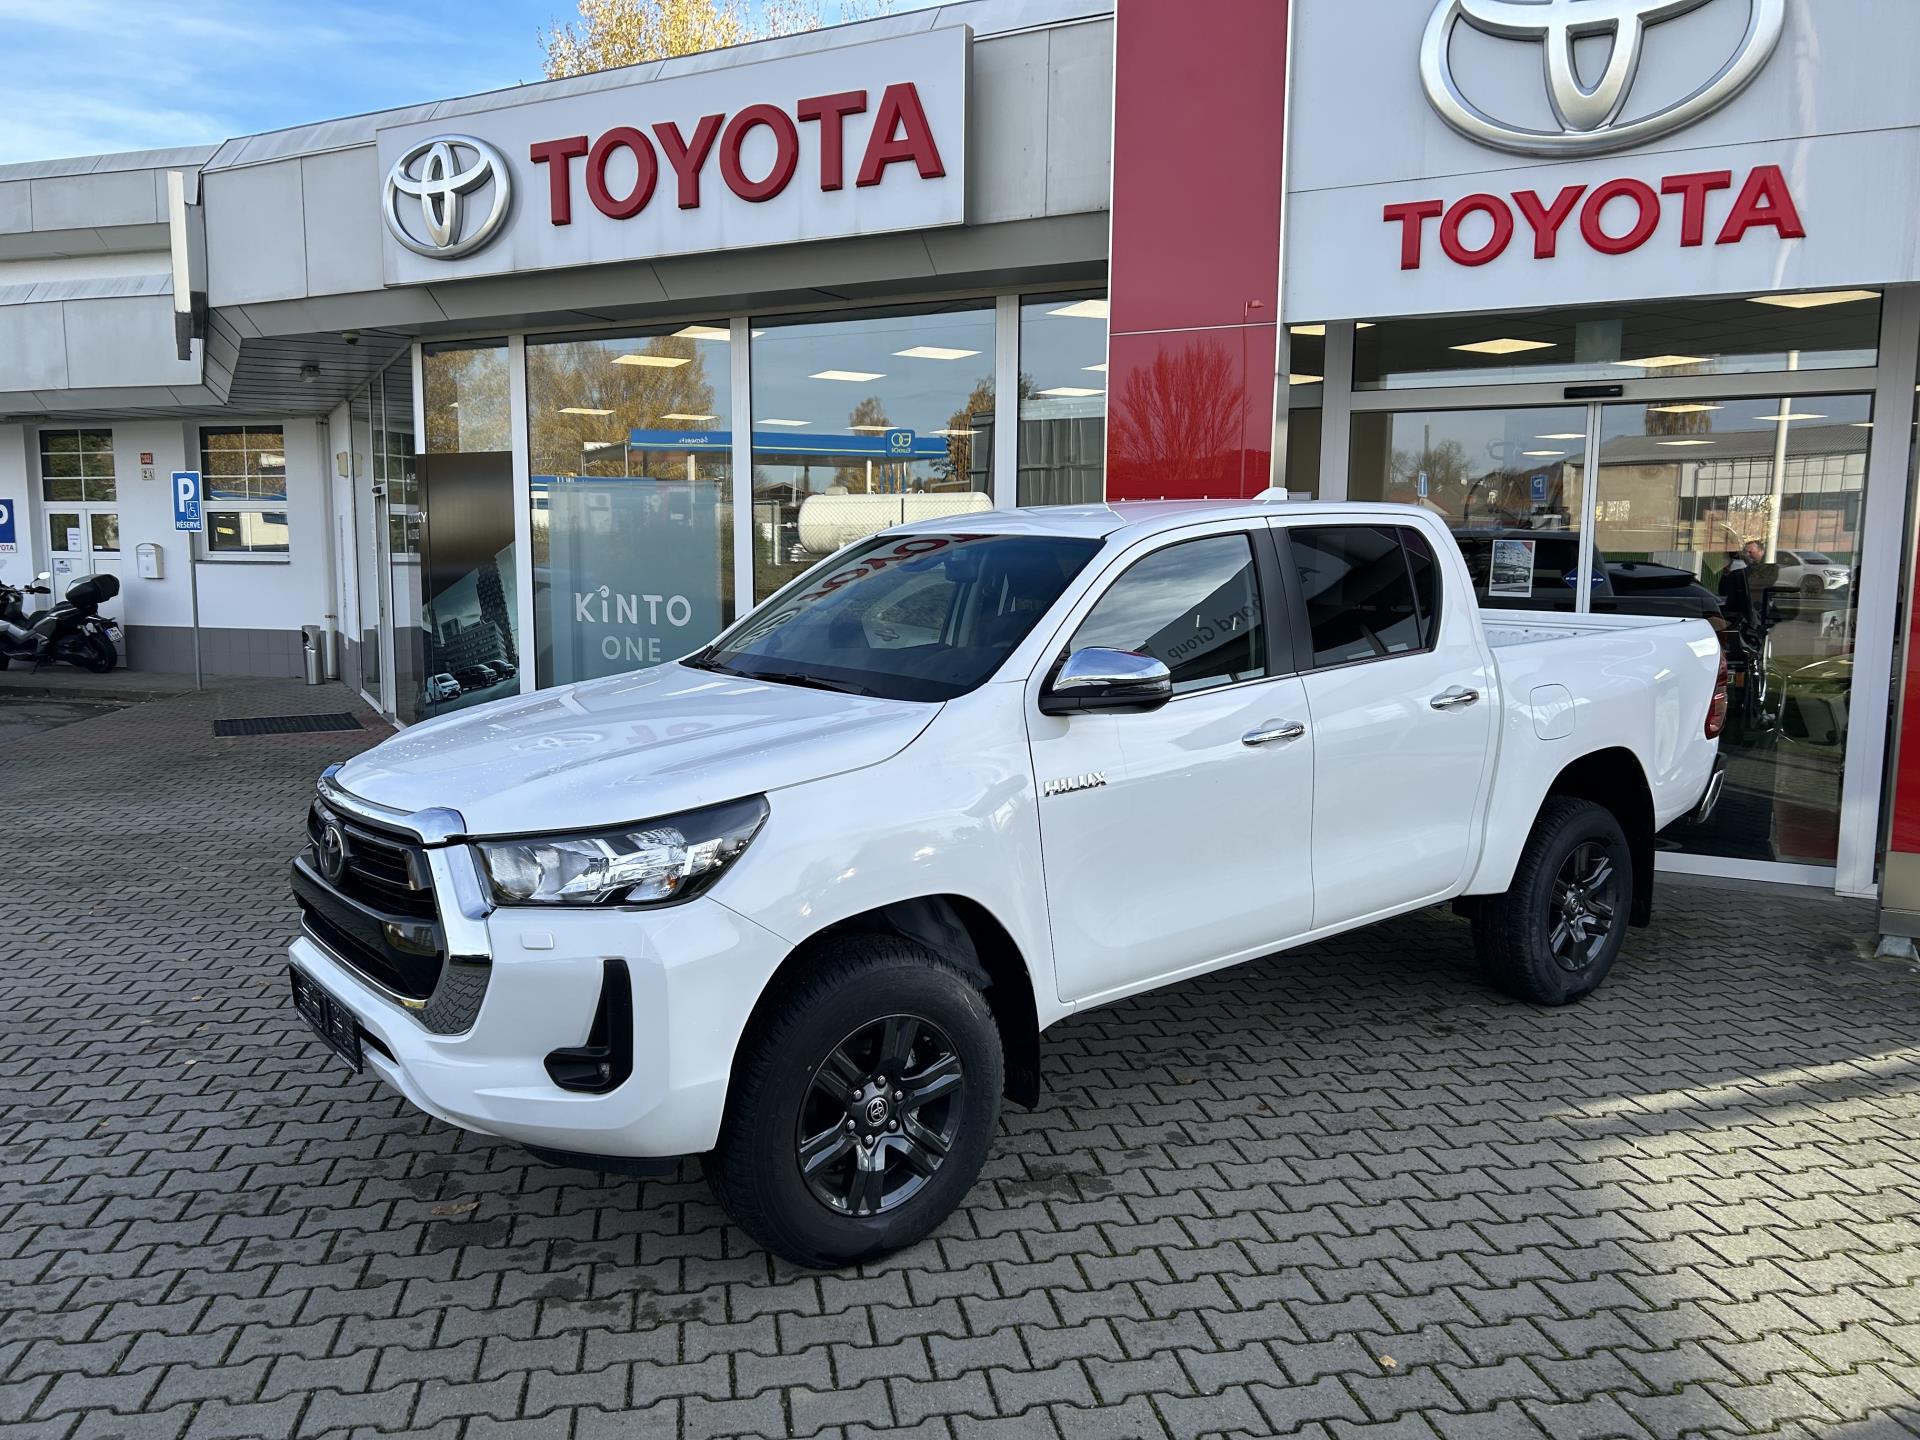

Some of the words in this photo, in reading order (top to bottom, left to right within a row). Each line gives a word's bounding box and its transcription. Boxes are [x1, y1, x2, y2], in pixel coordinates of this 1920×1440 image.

[530, 82, 946, 226] TOYOTA
[1383, 164, 1807, 270] TOYOTA
[177, 477, 195, 513] P
[601, 635, 661, 662] ONE
[1043, 770, 1108, 798] HILUX
